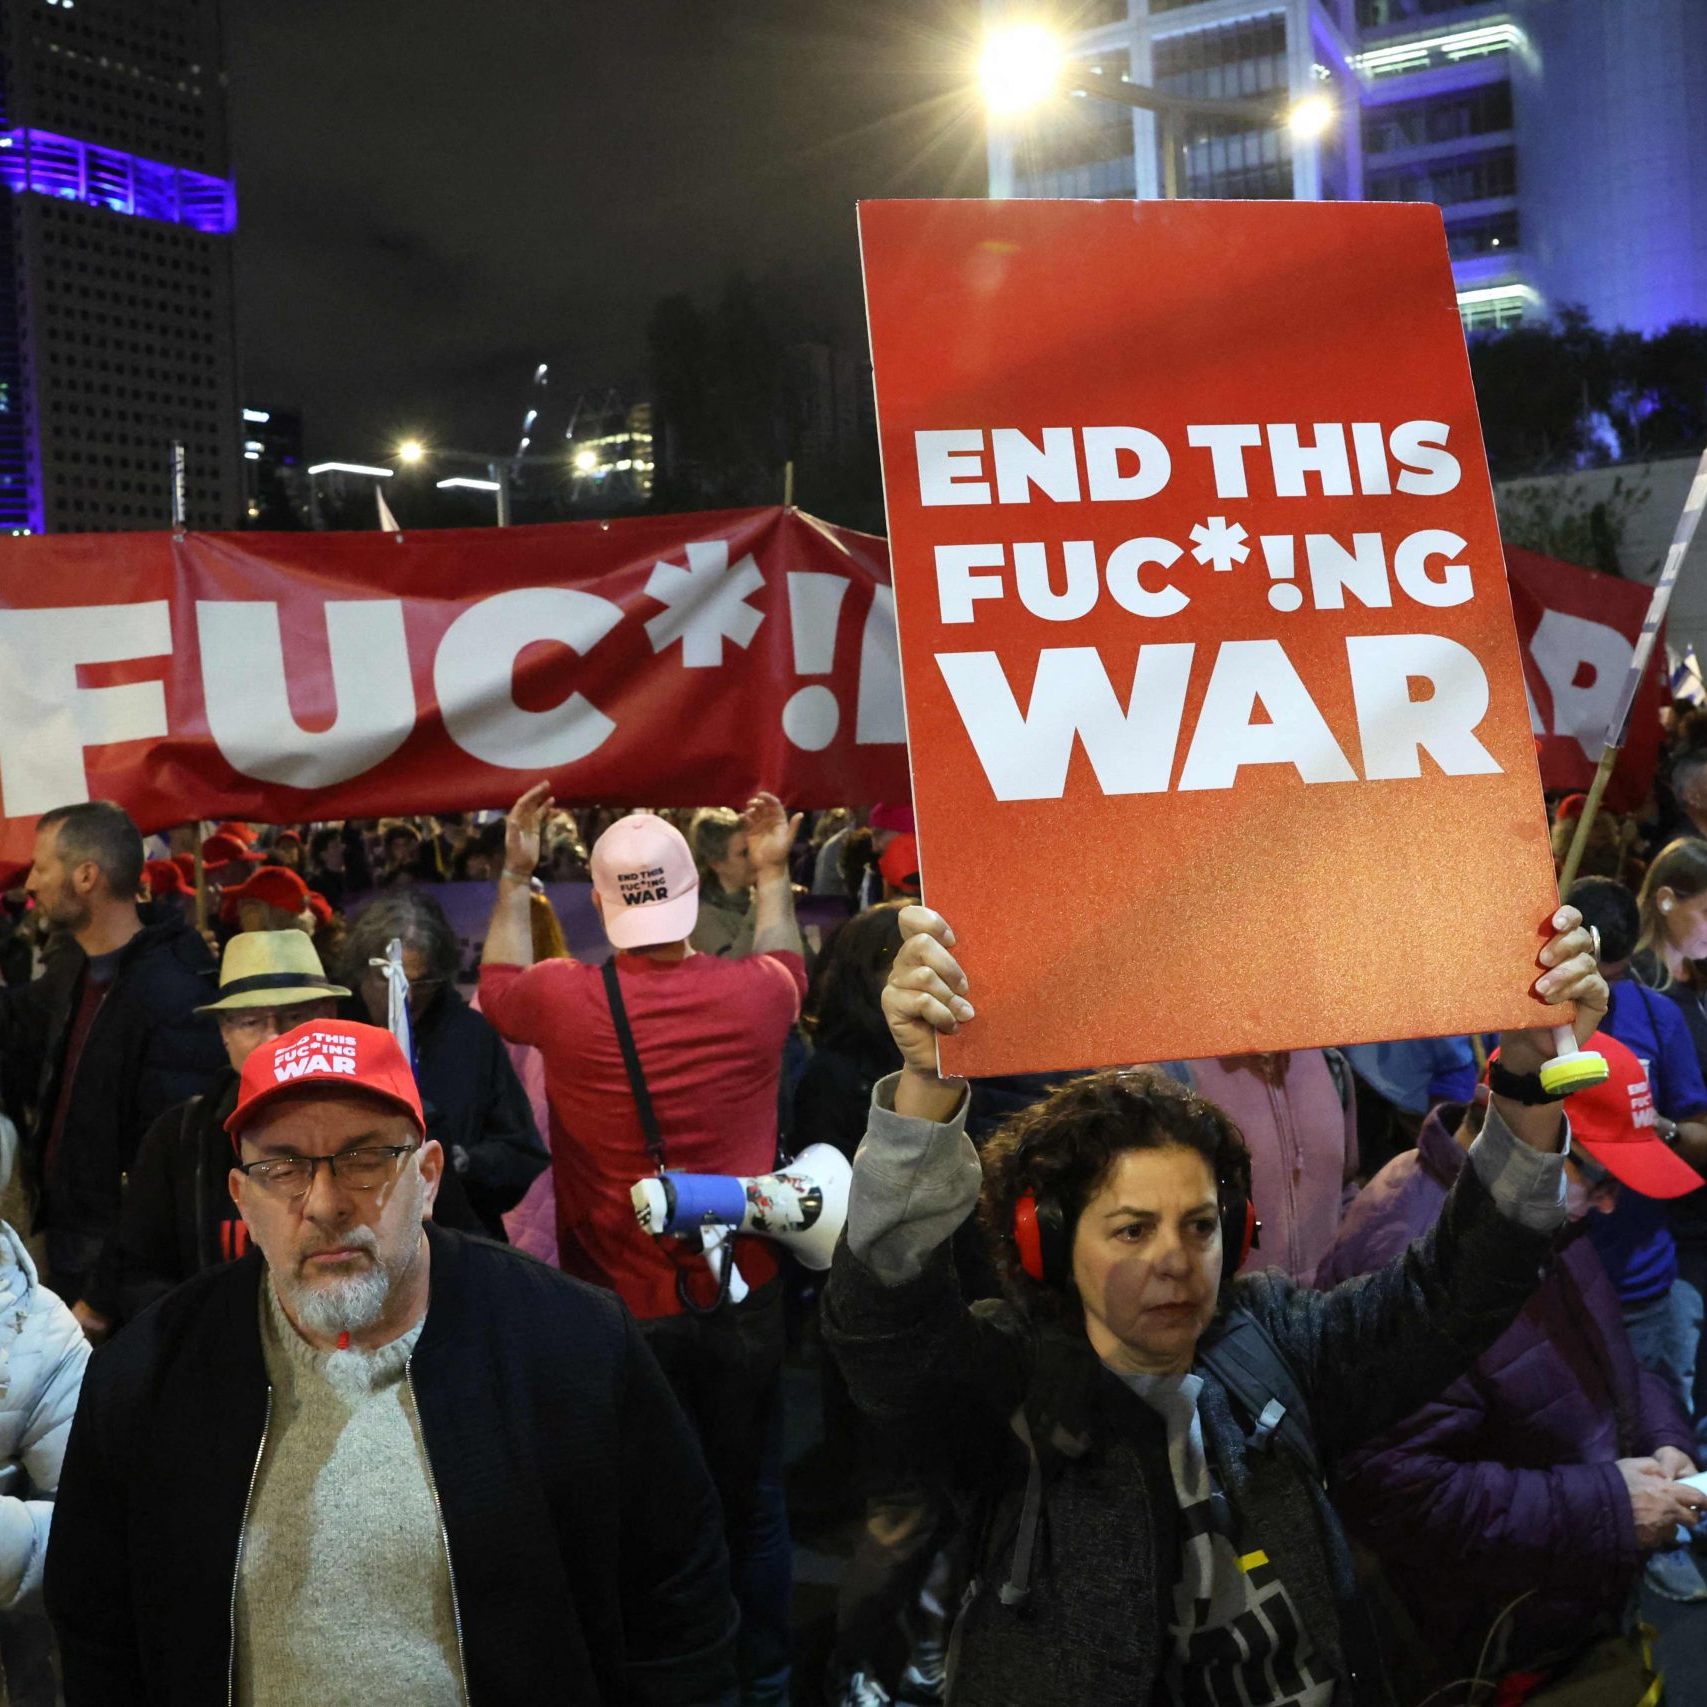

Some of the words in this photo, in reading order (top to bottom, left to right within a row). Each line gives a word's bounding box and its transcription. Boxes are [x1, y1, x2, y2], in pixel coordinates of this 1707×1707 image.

[914, 425, 1172, 507] END
[1186, 419, 1462, 499] THIS
[0, 539, 908, 818] FUC!
[933, 633, 1505, 802] WAR
[618, 873, 638, 882] END
[640, 867, 664, 879] THIS
[623, 887, 668, 906] WAR
[312, 1032, 357, 1046] THIS
[273, 1054, 356, 1082] WAR
